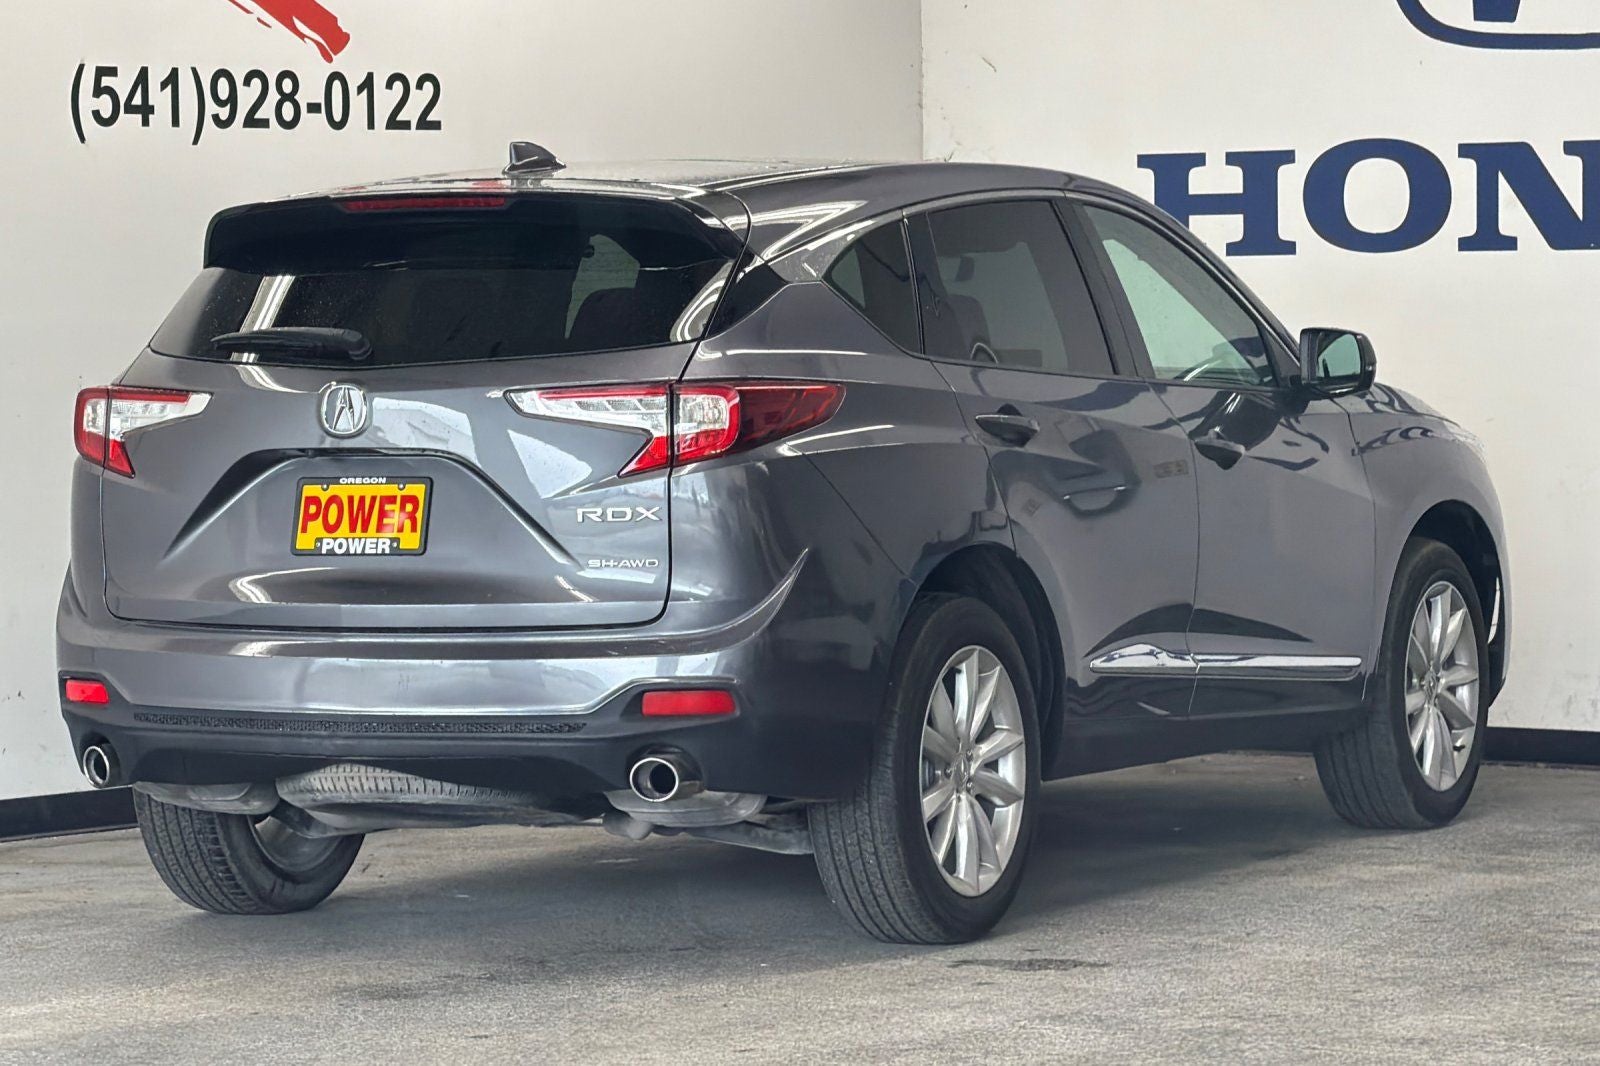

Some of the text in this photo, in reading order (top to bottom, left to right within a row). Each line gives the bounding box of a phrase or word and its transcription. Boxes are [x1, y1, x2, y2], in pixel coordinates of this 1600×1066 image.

[71, 63, 443, 145] (541)928-0122
[339, 476, 387, 485] OREGON
[301, 494, 420, 534] POWER
[576, 506, 661, 523] RDX
[321, 538, 391, 554] POWER
[587, 558, 659, 569] SH-AWD
